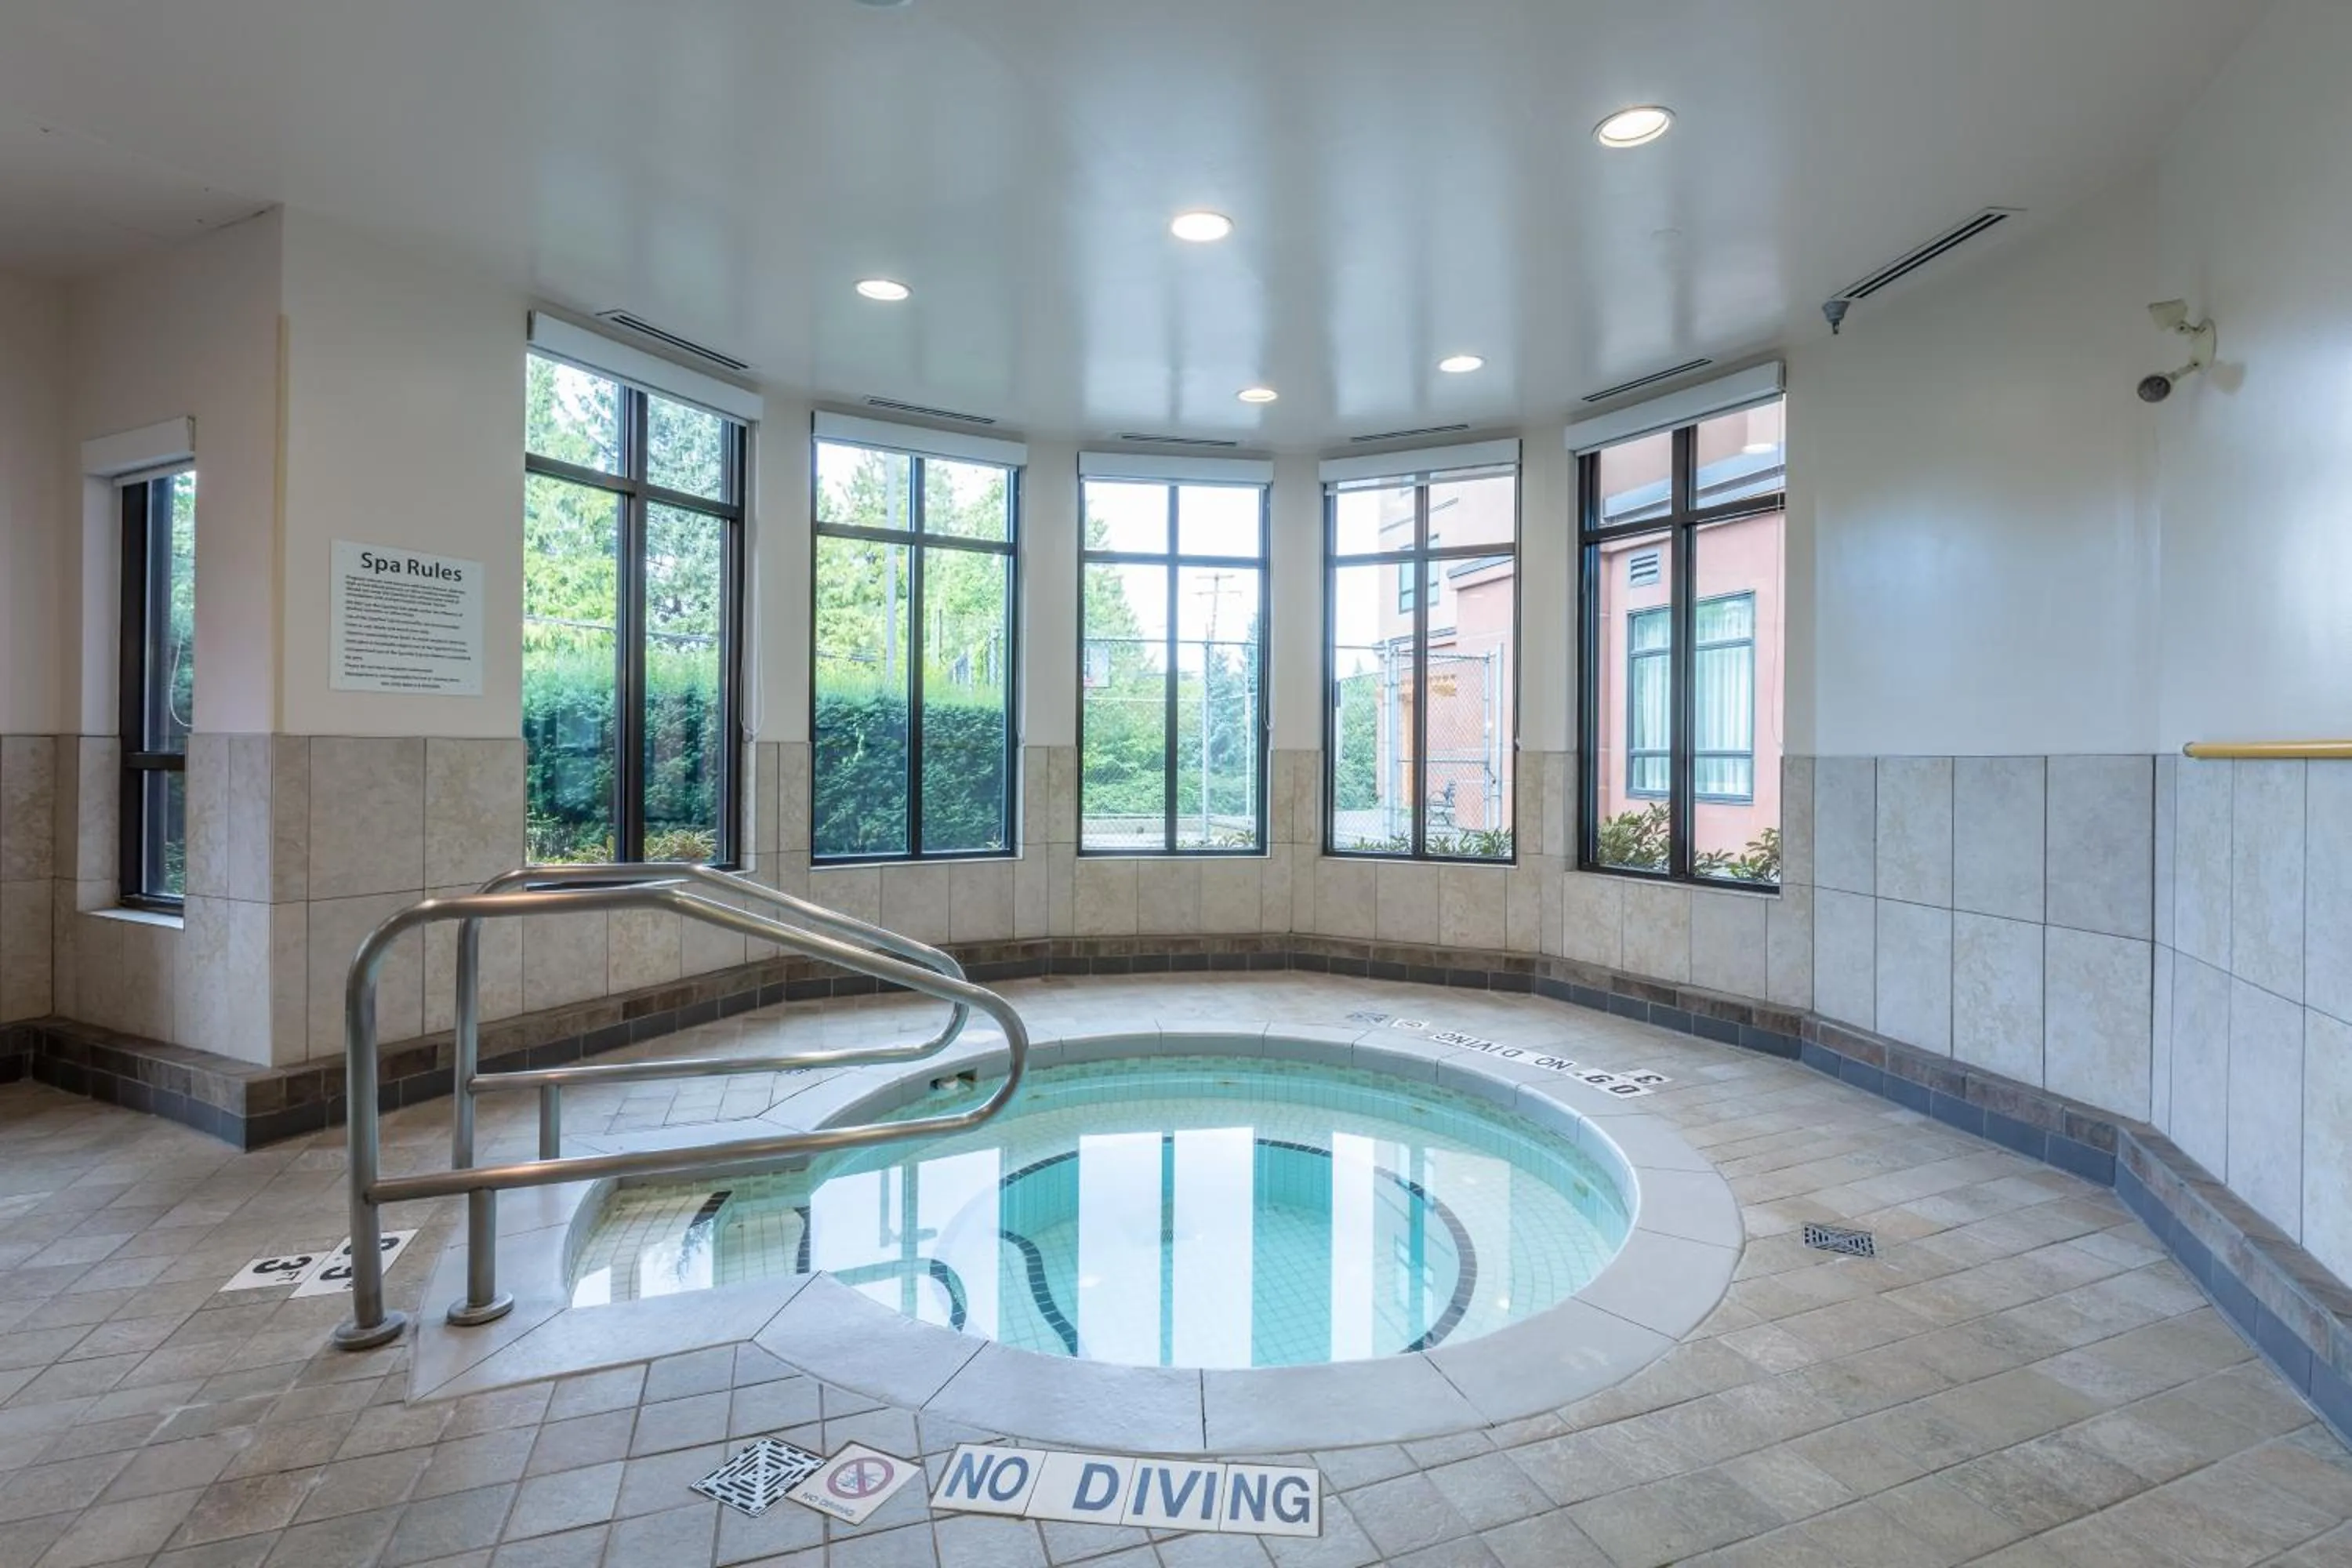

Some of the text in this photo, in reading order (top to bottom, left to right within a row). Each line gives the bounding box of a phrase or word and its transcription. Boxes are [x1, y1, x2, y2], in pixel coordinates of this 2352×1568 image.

[361, 552, 463, 582] Spa Rules
[1436, 1033, 1573, 1070] NO DIVING
[252, 1256, 313, 1273] 3
[944, 1453, 1311, 1523] NO DIVING
[801, 1492, 855, 1517] NO DIVING
